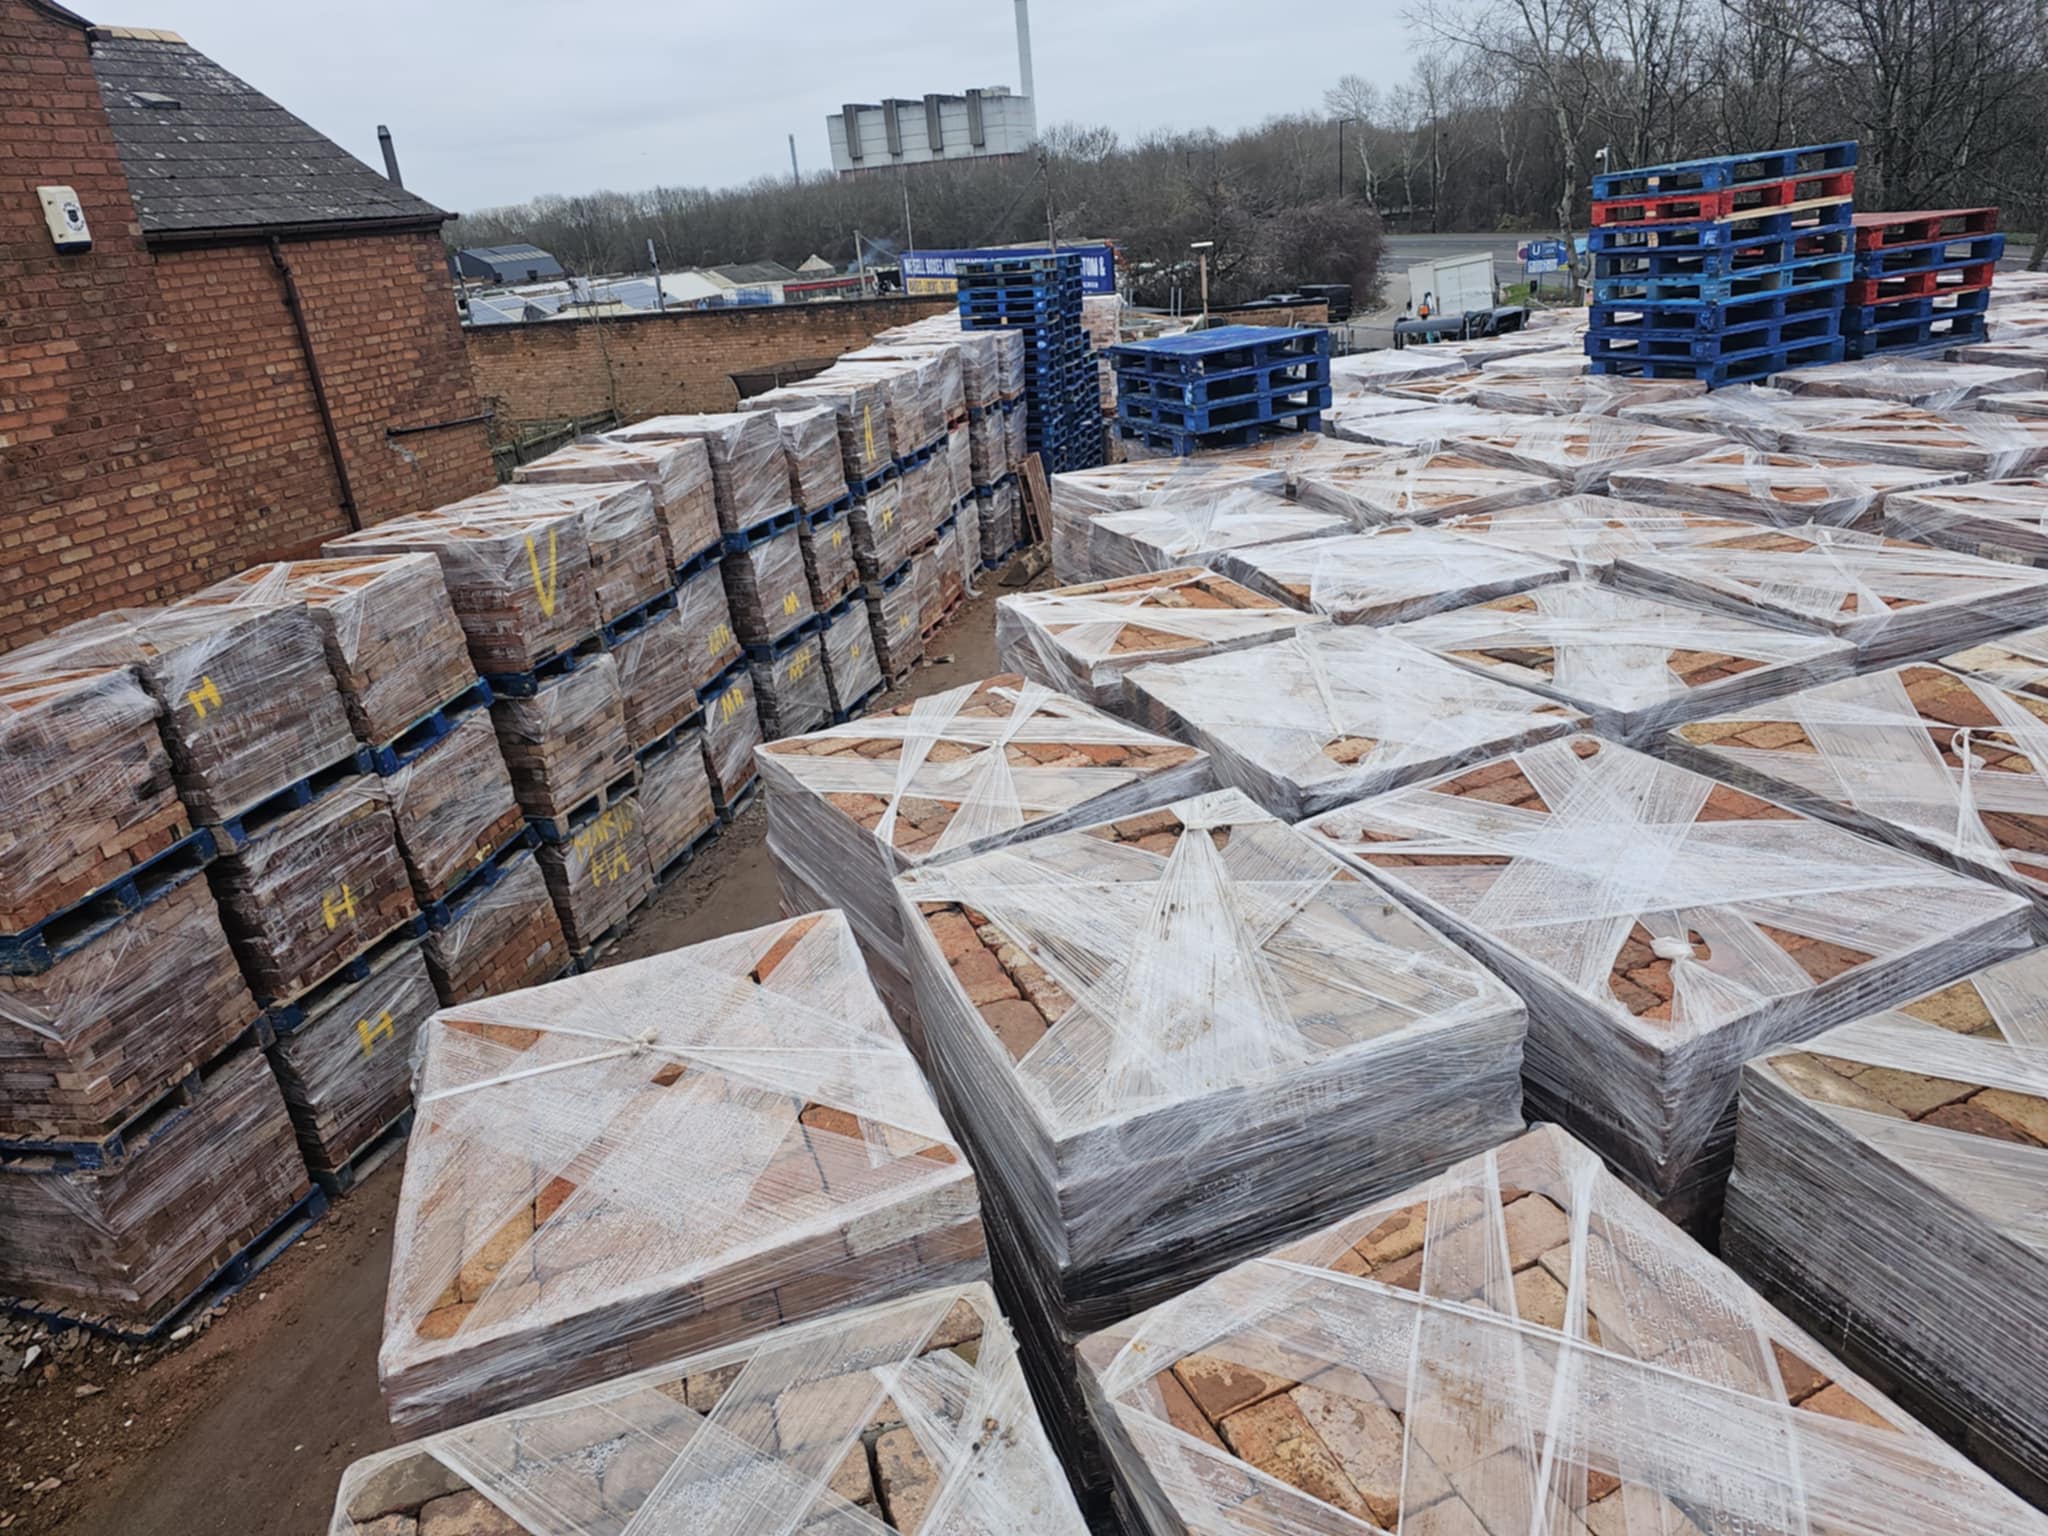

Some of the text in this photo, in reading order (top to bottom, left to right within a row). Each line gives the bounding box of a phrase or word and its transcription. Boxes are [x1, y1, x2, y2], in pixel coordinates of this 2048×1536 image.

[525, 529, 557, 617] V
[188, 676, 222, 718] H
[323, 884, 356, 929] H
[358, 1010, 394, 1056] H
